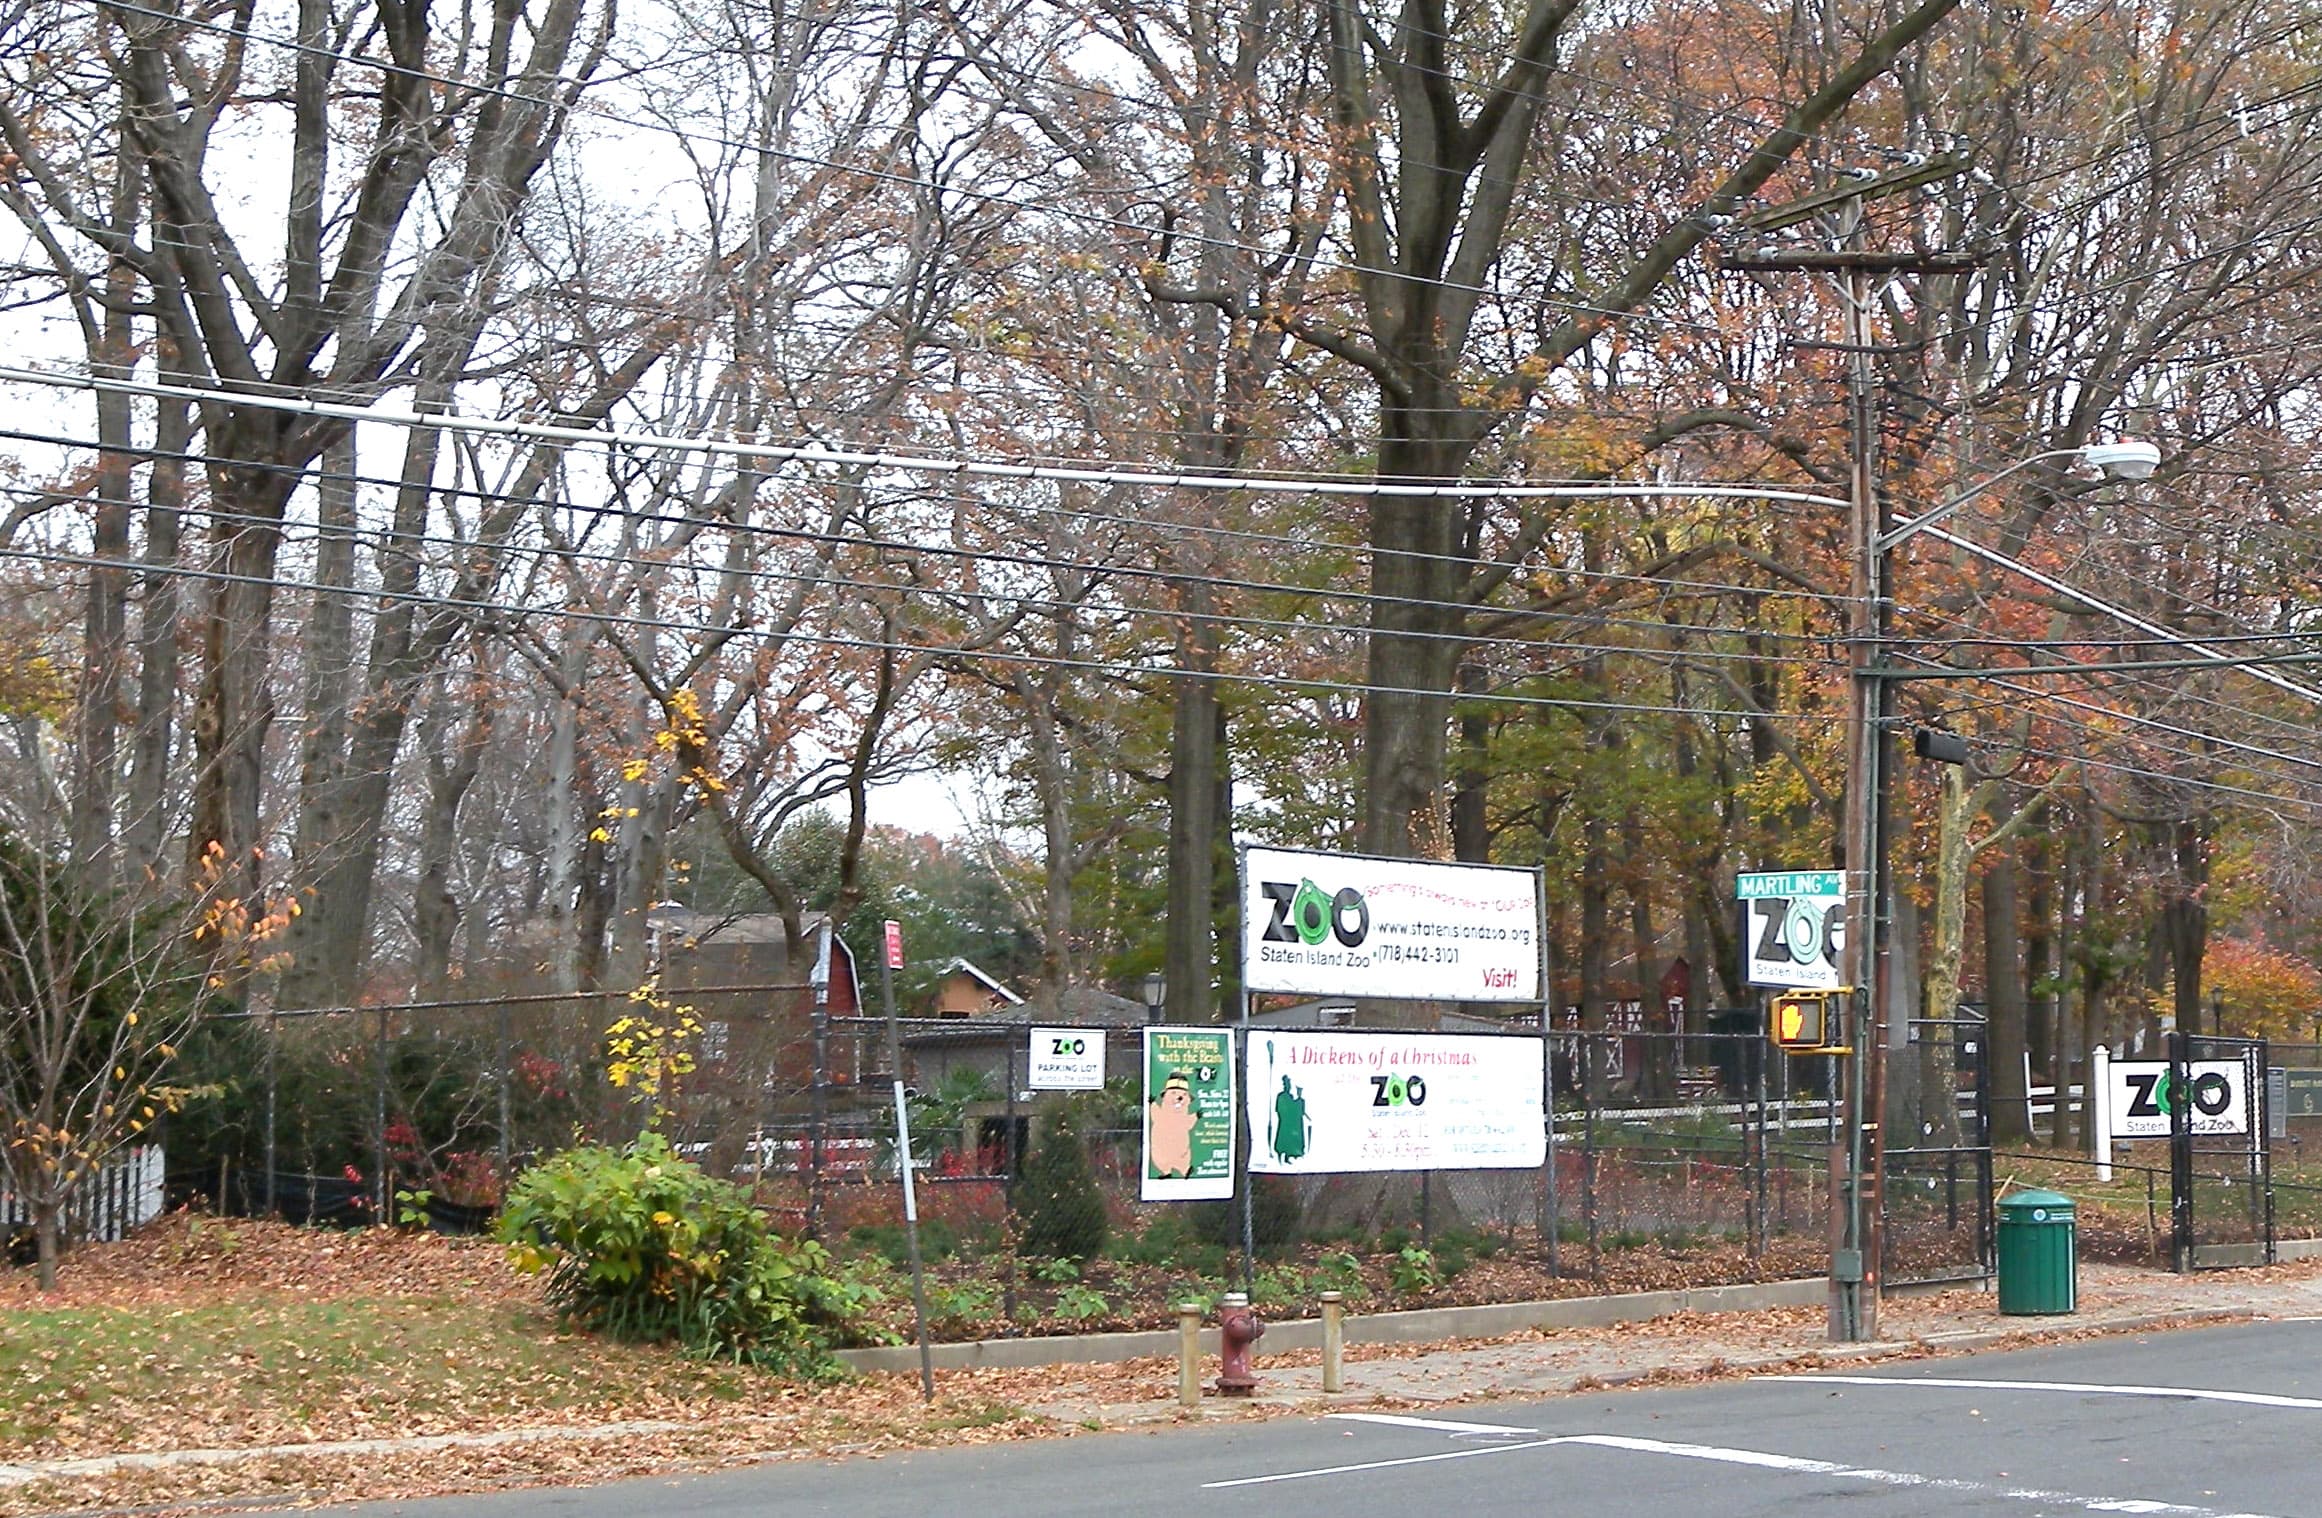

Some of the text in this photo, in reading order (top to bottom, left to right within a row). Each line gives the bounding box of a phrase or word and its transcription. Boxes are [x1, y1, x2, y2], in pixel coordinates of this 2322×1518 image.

[1741, 875, 1822, 895] MARTLING
[1261, 878, 1369, 948] ZOO
[1378, 922, 1530, 945] www.statenislandzoo.org
[1261, 946, 1370, 968] Staten Island Zoo
[1482, 968, 1518, 988] Visit!
[1757, 964, 1826, 980] Staten Island
[1052, 1038, 1085, 1055] ZOO
[1158, 1035, 1219, 1053] Thanksgiving
[1158, 1050, 1180, 1062] with
[1183, 1050, 1198, 1062] the
[1302, 1046, 1364, 1065] Dickens
[1369, 1046, 1385, 1071] of
[1390, 1052, 1399, 1065] a
[1403, 1047, 1479, 1065] Christmas
[1038, 1064, 1097, 1072] PARKING LOT
[1371, 1072, 1426, 1106] ZOO
[2127, 1121, 2165, 1132] Staten
[2207, 1120, 2233, 1131] Zoo
